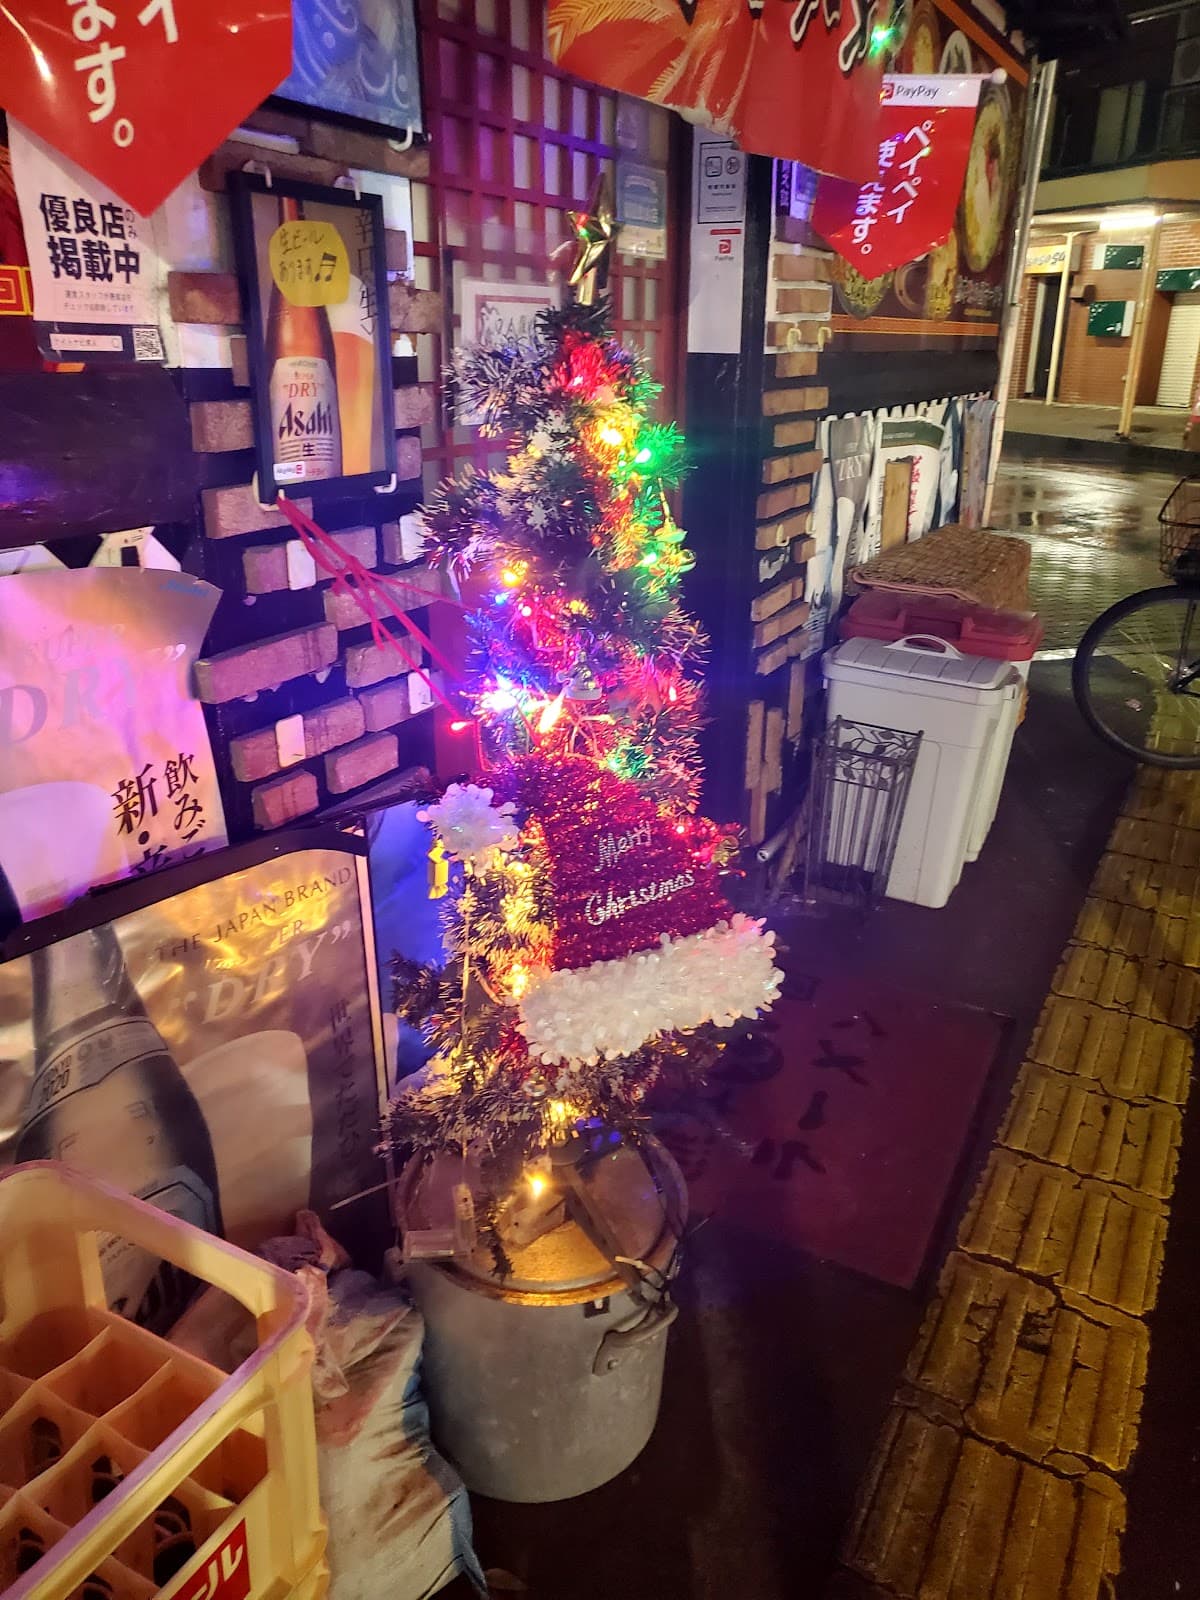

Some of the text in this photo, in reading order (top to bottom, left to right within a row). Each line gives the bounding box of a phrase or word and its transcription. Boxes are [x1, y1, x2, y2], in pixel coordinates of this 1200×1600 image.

[896, 85, 940, 99] PayPay
[886, 119, 936, 224] ペイペイ
[48, 235, 139, 284] 掲載中
[279, 401, 333, 440] Asahi
[302, 442, 316, 457] 生
[212, 901, 276, 944] JAPAN
[282, 866, 353, 909] BRAND
[585, 869, 696, 925] Christmas
